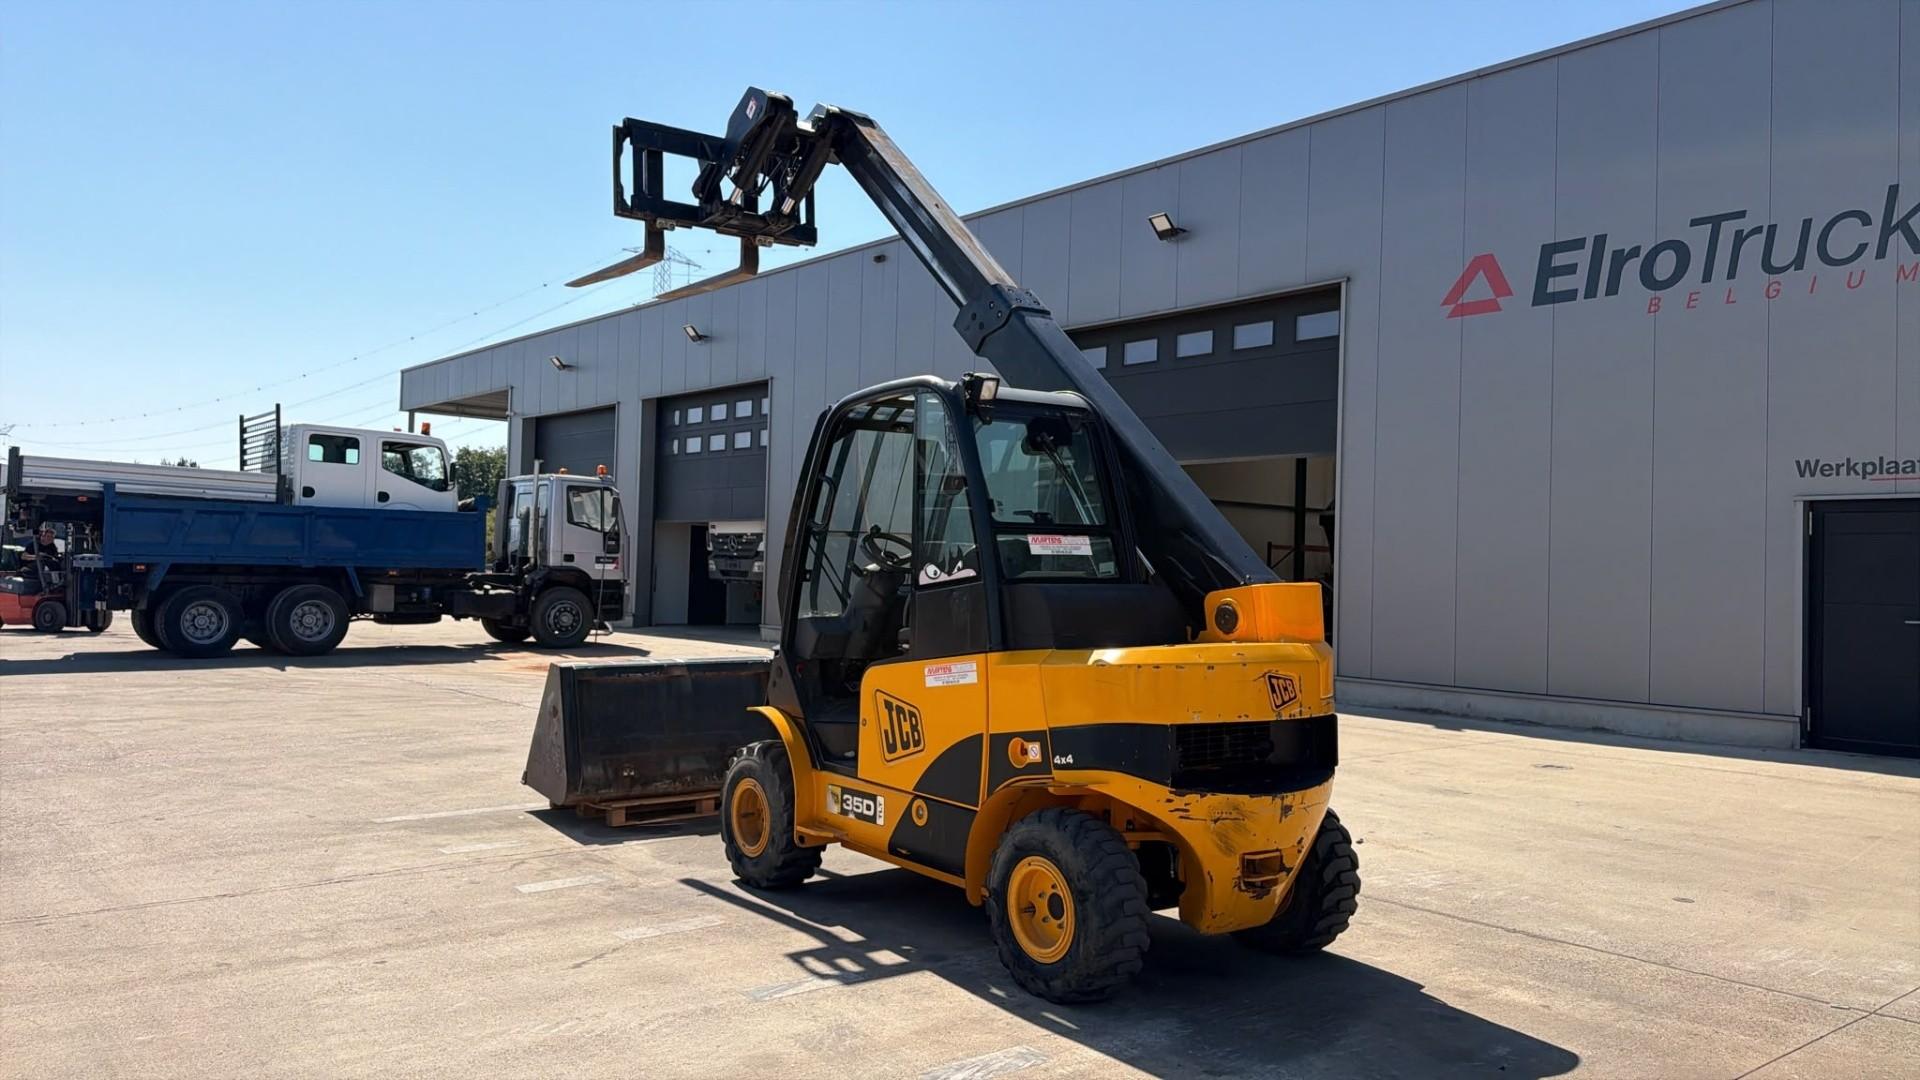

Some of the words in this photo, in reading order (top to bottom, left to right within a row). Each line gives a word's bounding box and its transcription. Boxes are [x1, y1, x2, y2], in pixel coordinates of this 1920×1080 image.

[1531, 184, 1920, 307] ElroTruck
[1647, 262, 1919, 314] BELGIUM
[1270, 678, 1295, 706] JCB
[883, 698, 922, 754] JCB
[1053, 754, 1073, 764] 4x4
[842, 794, 875, 816] 35D
